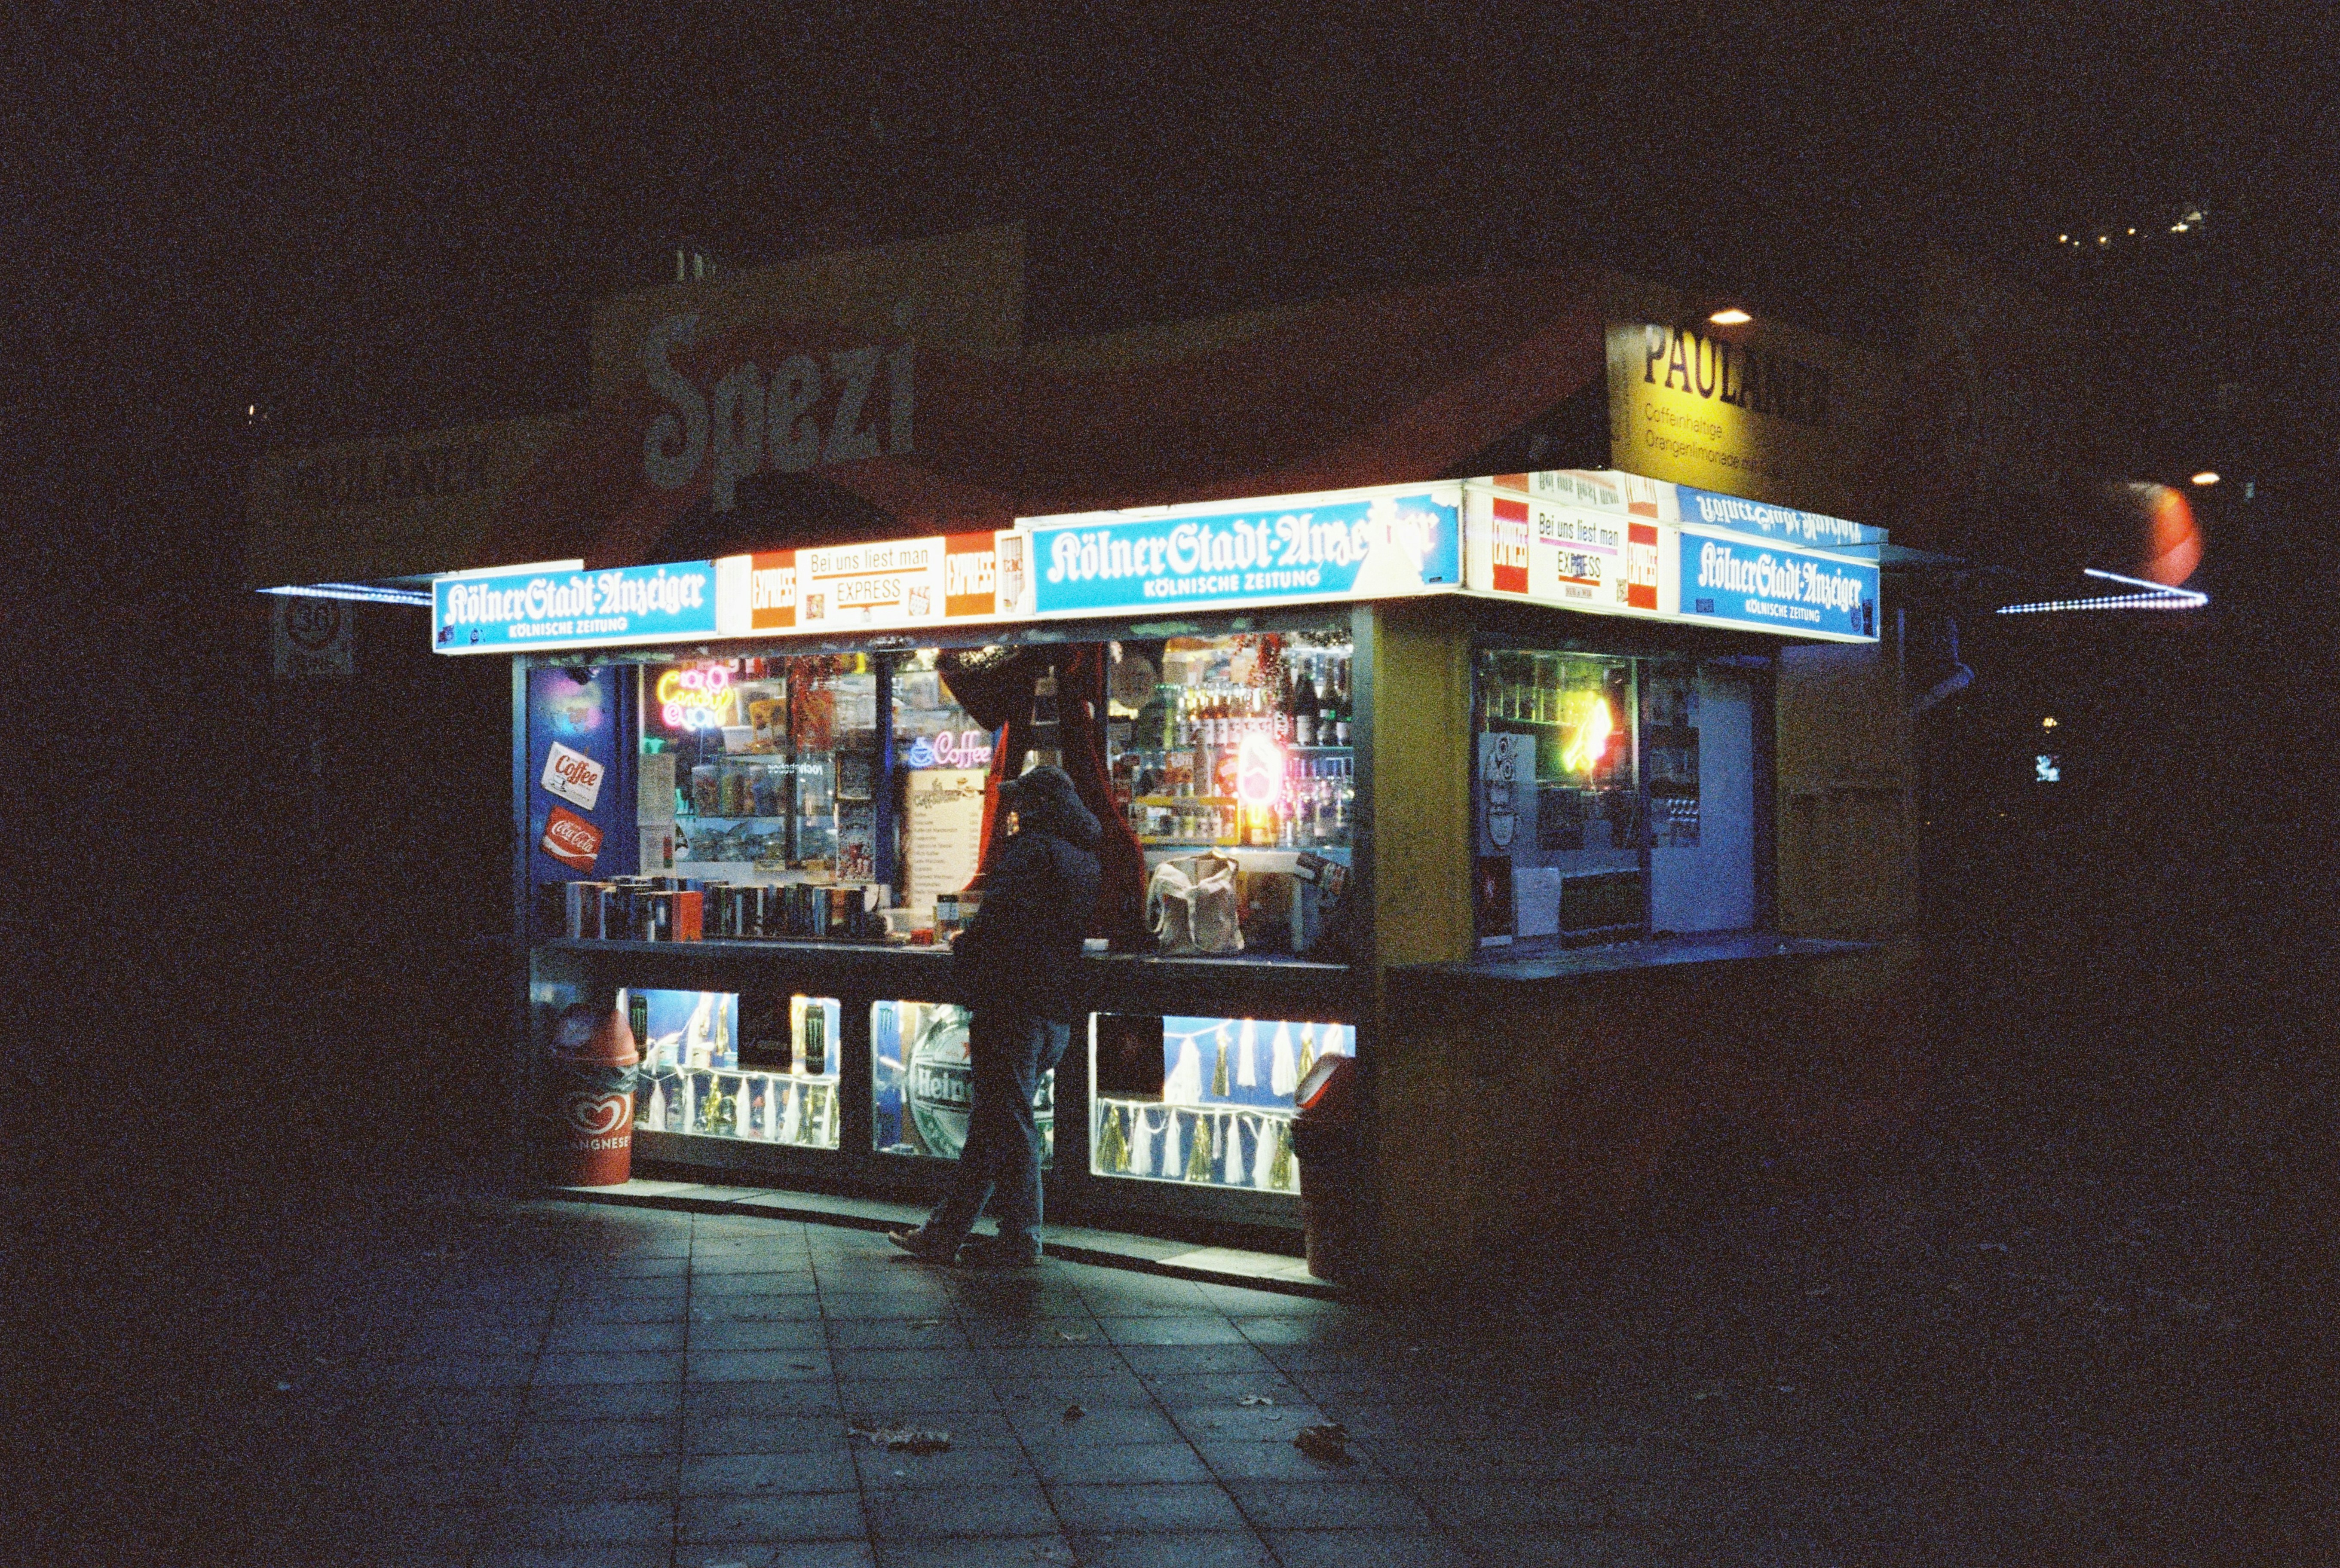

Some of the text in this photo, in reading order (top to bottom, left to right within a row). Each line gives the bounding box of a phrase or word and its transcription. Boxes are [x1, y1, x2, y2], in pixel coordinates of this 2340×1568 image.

[643, 301, 916, 513] Spezi
[1645, 403, 1722, 441] Coffeinhaltige
[1047, 511, 1439, 582] Kölner Stadt-Anzeer
[1539, 512, 1618, 547] Bei uns liest man
[811, 548, 929, 573] Bei uns liest man
[946, 551, 995, 596] EXPRESS
[1698, 541, 1862, 612] Kölner Stadt-Anzeiger
[445, 569, 705, 624] Kölner Stadt-Anzeiger
[752, 567, 795, 609] EXPRESS
[838, 579, 901, 602] EXPRESS
[1144, 569, 1320, 598] KÖLNISCHE ZEITUNG
[508, 617, 628, 638] KÖLNISCHE ZEITUNG
[1746, 599, 1821, 623] KÖLNISCHE ZEITUNG
[658, 670, 734, 726] Candy
[933, 730, 992, 768] Coffee
[555, 755, 597, 786] Coffee
[568, 1136, 631, 1152] ANGNESE
